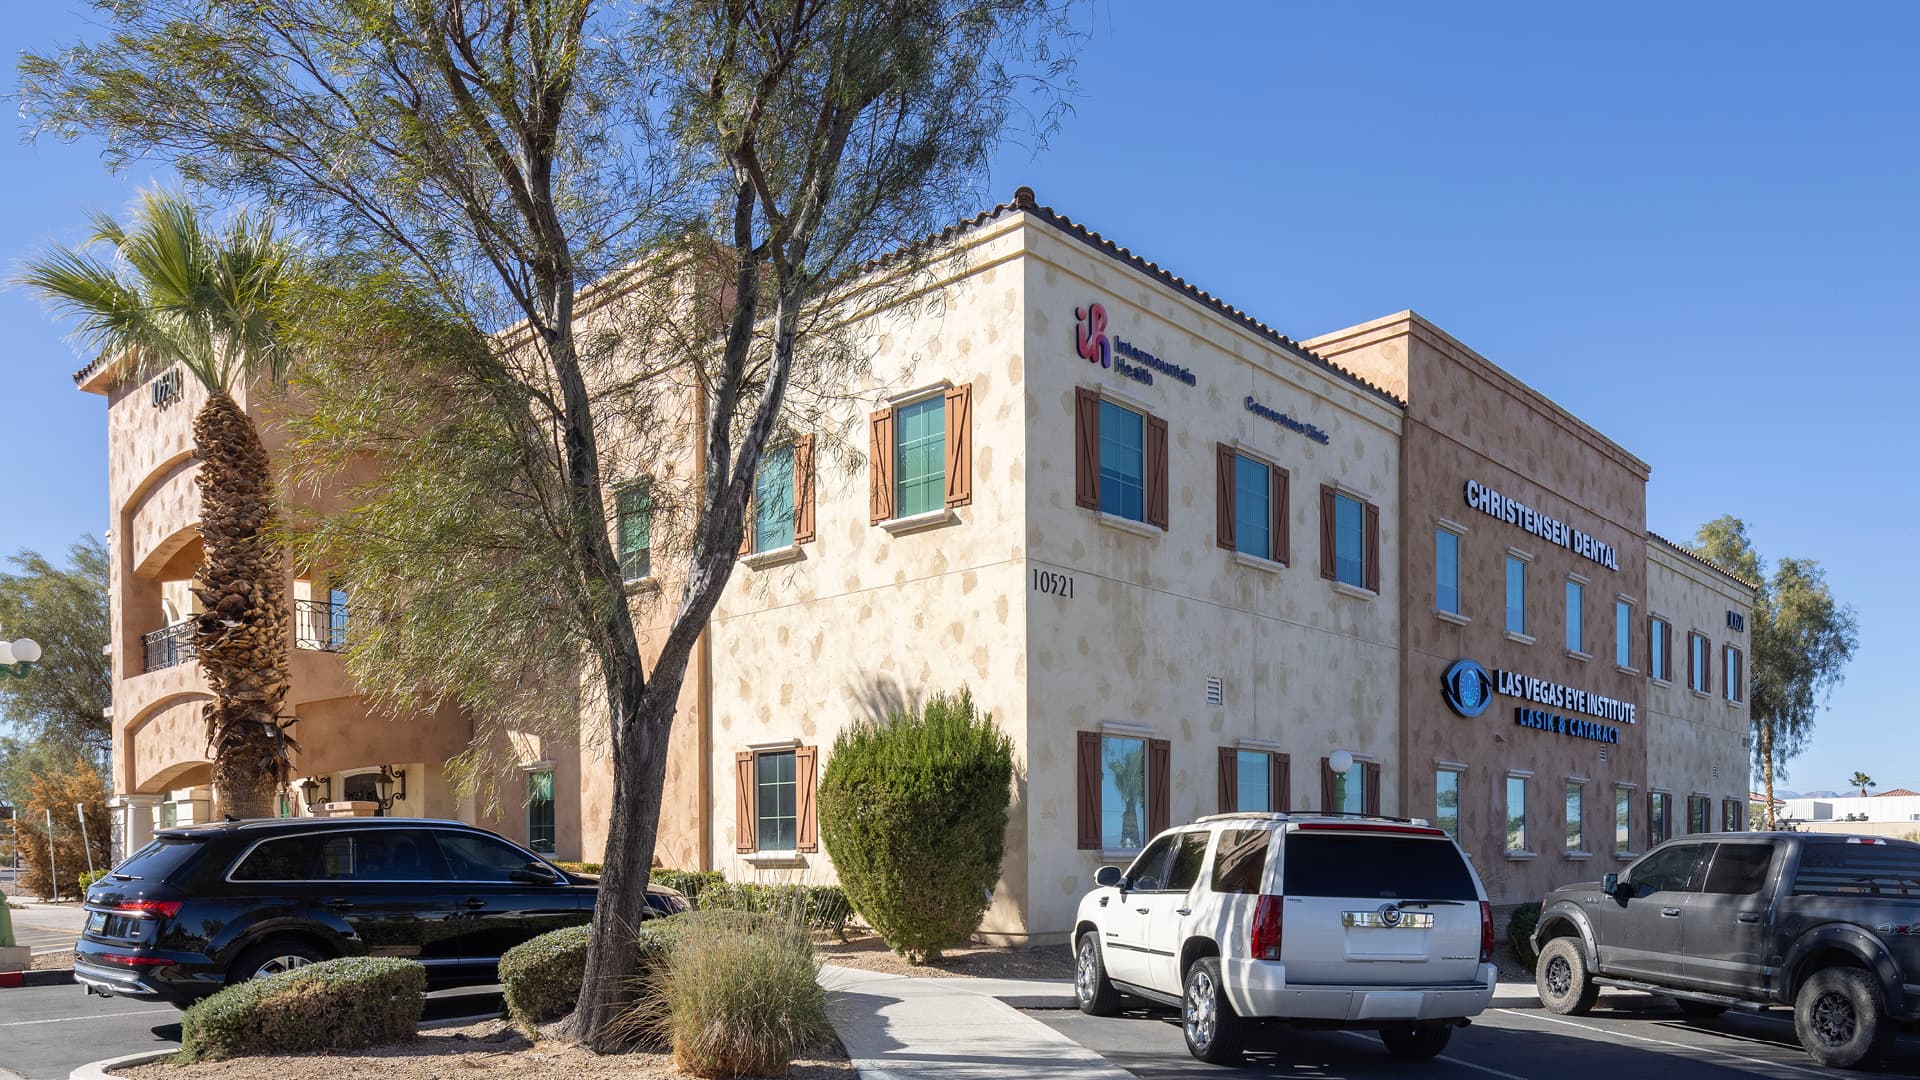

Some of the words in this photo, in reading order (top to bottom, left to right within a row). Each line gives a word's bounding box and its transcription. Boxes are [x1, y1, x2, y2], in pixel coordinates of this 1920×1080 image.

[1114, 335, 1196, 387] Intermountain
[1114, 355, 1153, 387] Health
[1304, 423, 1329, 446] Clinic
[1465, 479, 1571, 549] CHRISTENSEN
[1572, 529, 1619, 572] DENTAL
[1033, 569, 1074, 599] 10521
[1496, 669, 1523, 698] LAS
[1523, 675, 1564, 708] VEGAS
[1565, 686, 1586, 714] EYE
[1586, 692, 1637, 724] INSTITUTE
[1518, 708, 1555, 732] LASIK
[1557, 717, 1568, 733] &
[1569, 718, 1621, 745] CATARACT
